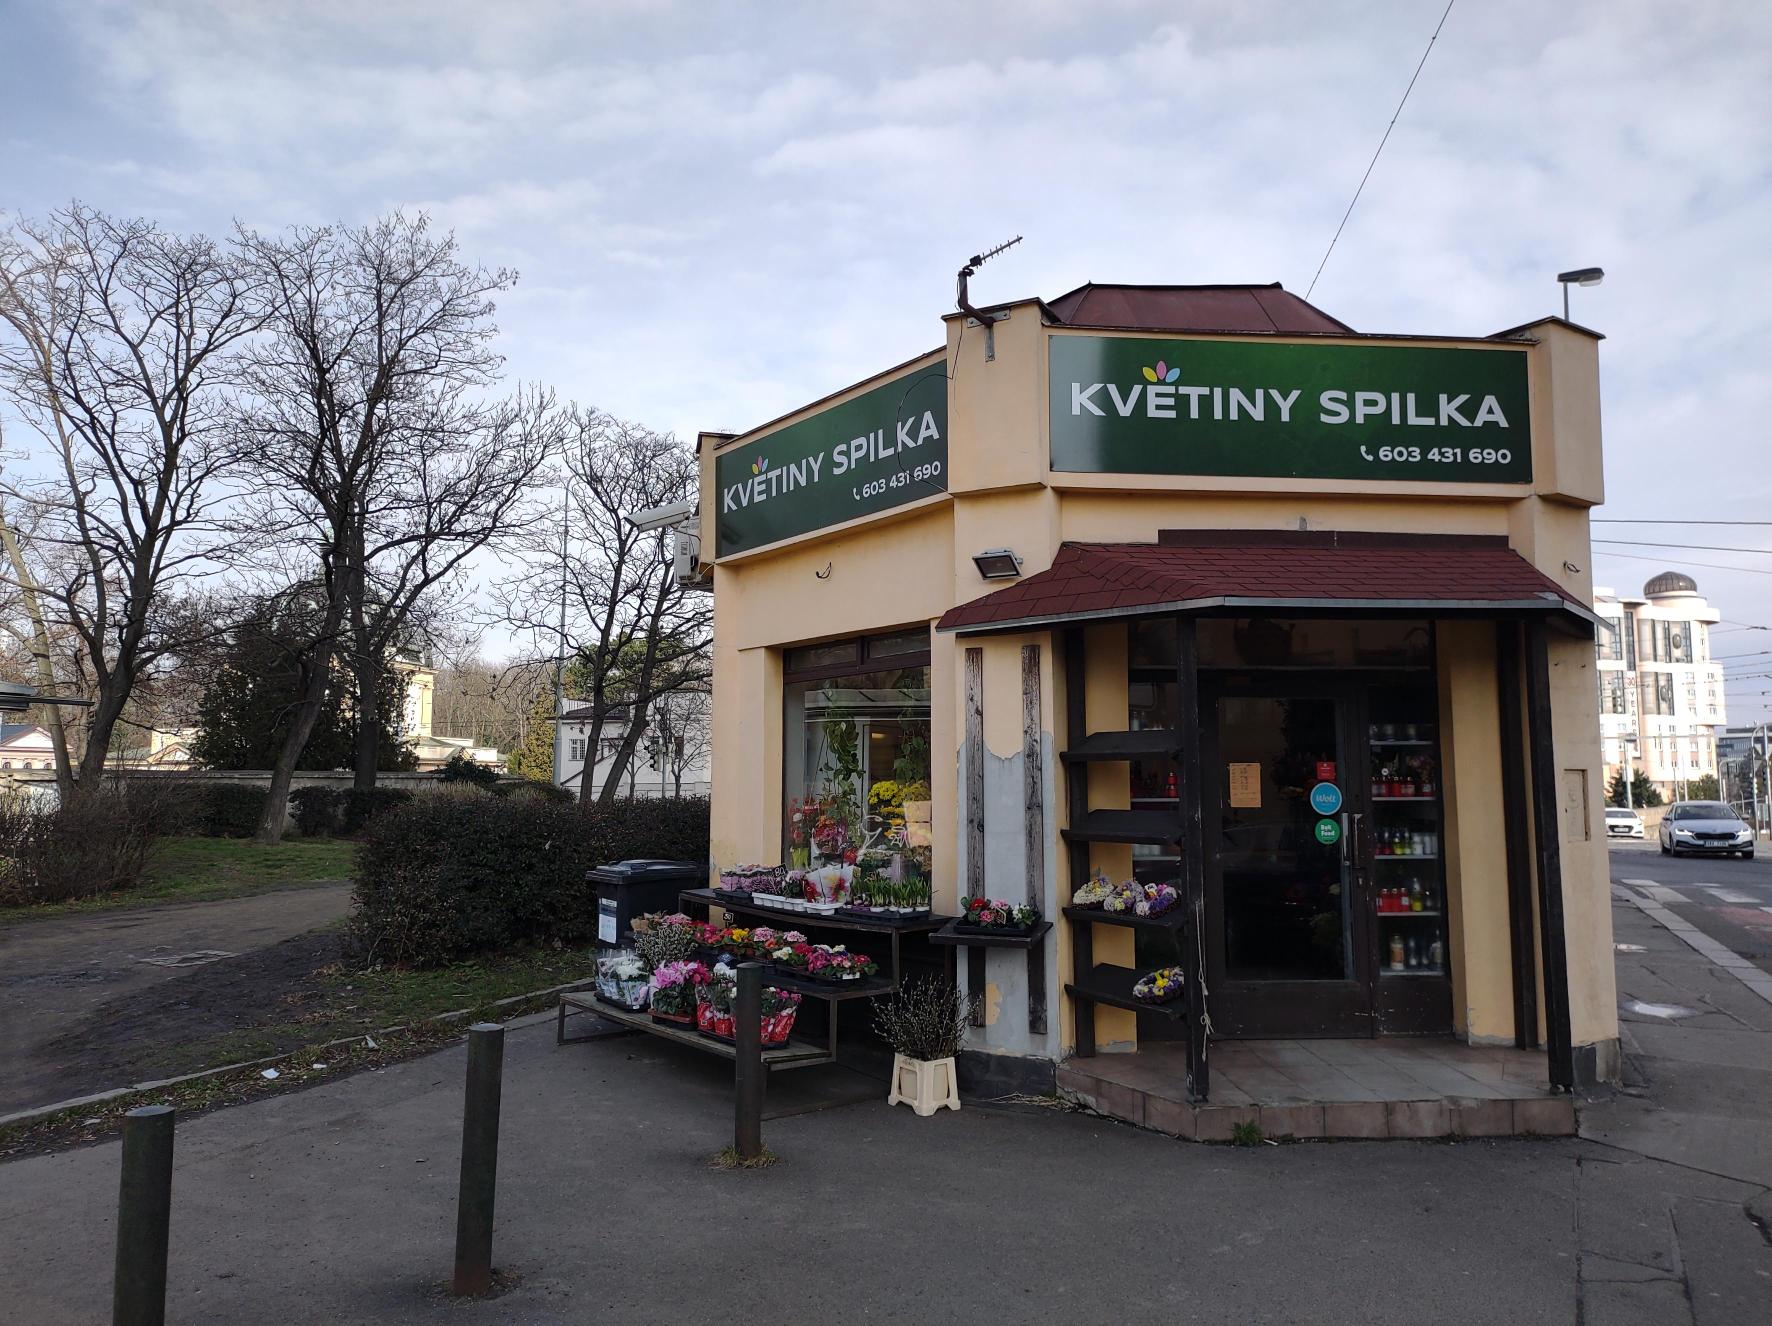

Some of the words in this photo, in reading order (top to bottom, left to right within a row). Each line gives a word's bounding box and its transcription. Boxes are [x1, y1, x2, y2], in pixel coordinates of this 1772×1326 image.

[1319, 390, 1509, 428] SPILKA
[832, 410, 940, 475] SPILKA
[1378, 446, 1421, 462] 603
[1427, 447, 1462, 463] 431
[1468, 448, 1512, 465] 690
[862, 478, 886, 498] 603
[889, 470, 910, 490] 431
[914, 460, 941, 481] 690
[1315, 794, 1336, 804] Wolt
